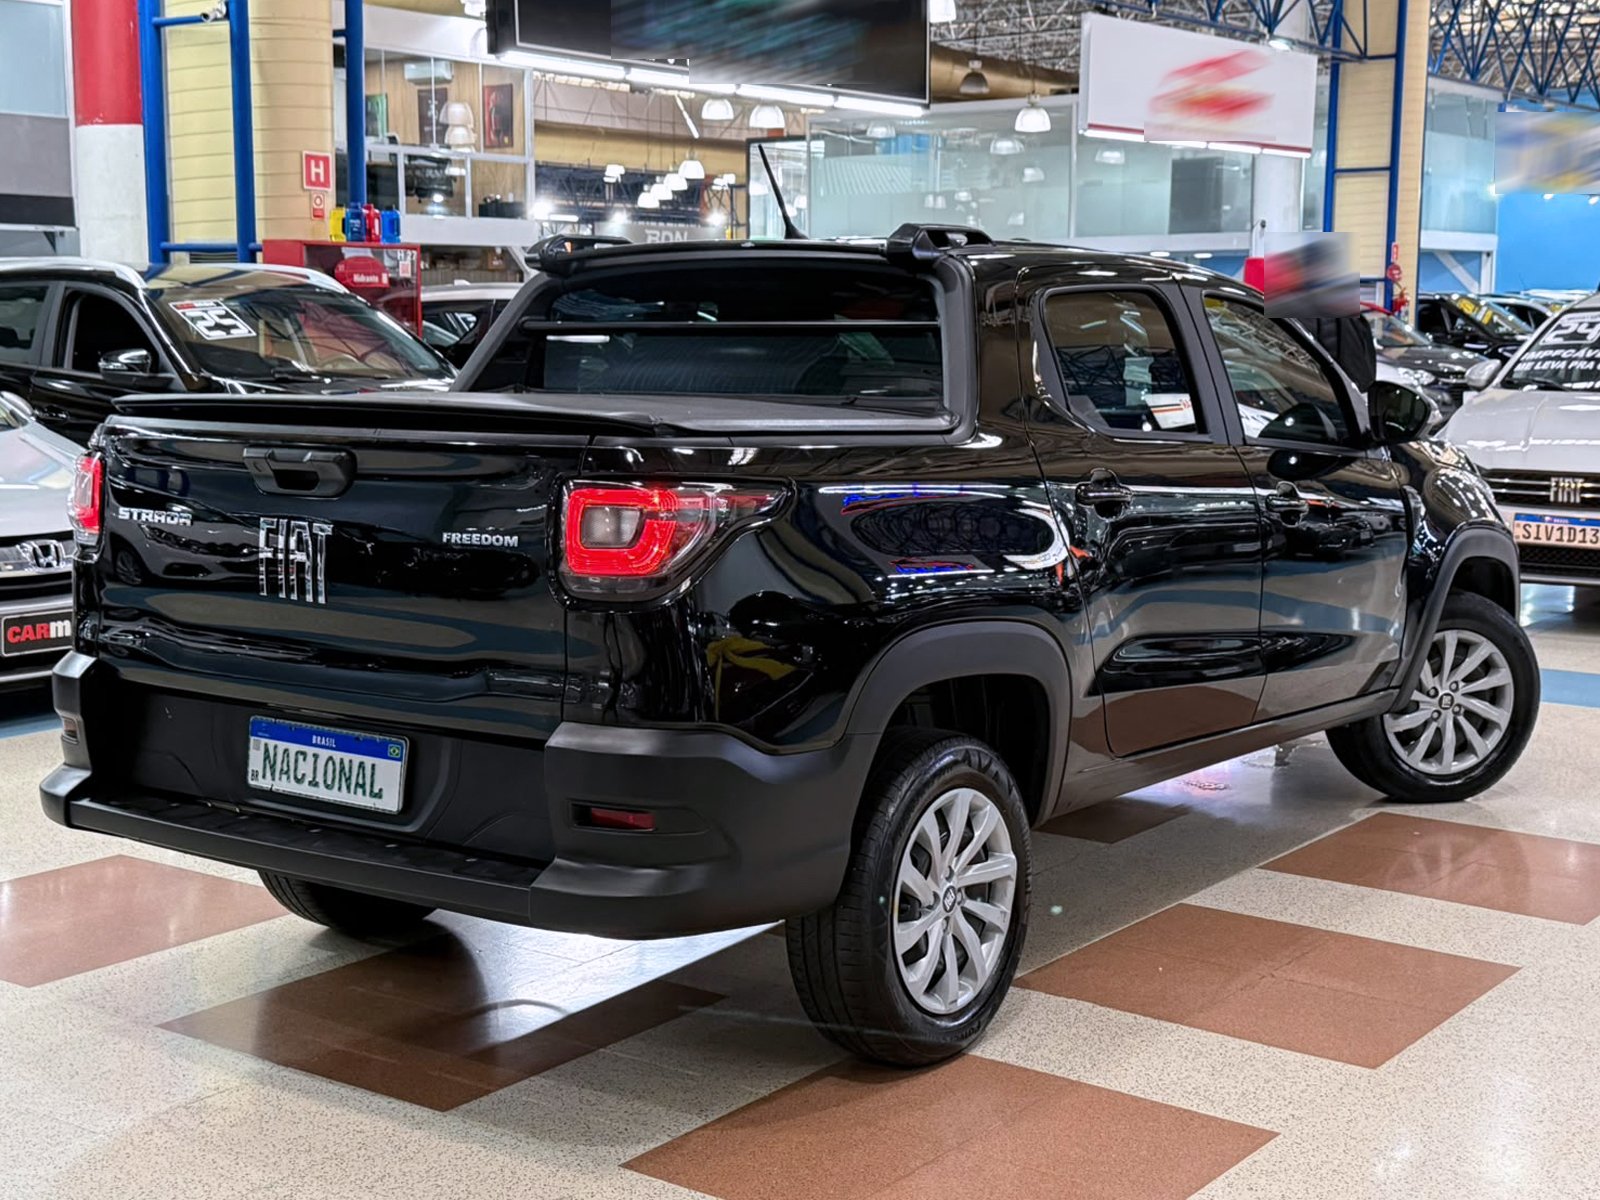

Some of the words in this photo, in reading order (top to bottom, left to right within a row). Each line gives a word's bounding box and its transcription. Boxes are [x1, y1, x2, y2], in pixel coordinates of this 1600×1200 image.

[309, 159, 325, 183] H
[353, 272, 379, 283] Hidrante
[185, 309, 249, 337] 25
[1544, 320, 1600, 342] 24
[1533, 360, 1567, 371] LEVA
[1567, 360, 1595, 371] PRA
[1549, 476, 1585, 503] FIAT
[118, 506, 192, 527] STRADA
[442, 532, 519, 548] FREEDOM
[1521, 523, 1600, 544] SIV1D13
[259, 517, 334, 604] FIAT
[312, 734, 337, 748] BRASIL
[250, 769, 259, 782] BR
[262, 742, 384, 800] NACIONAL
